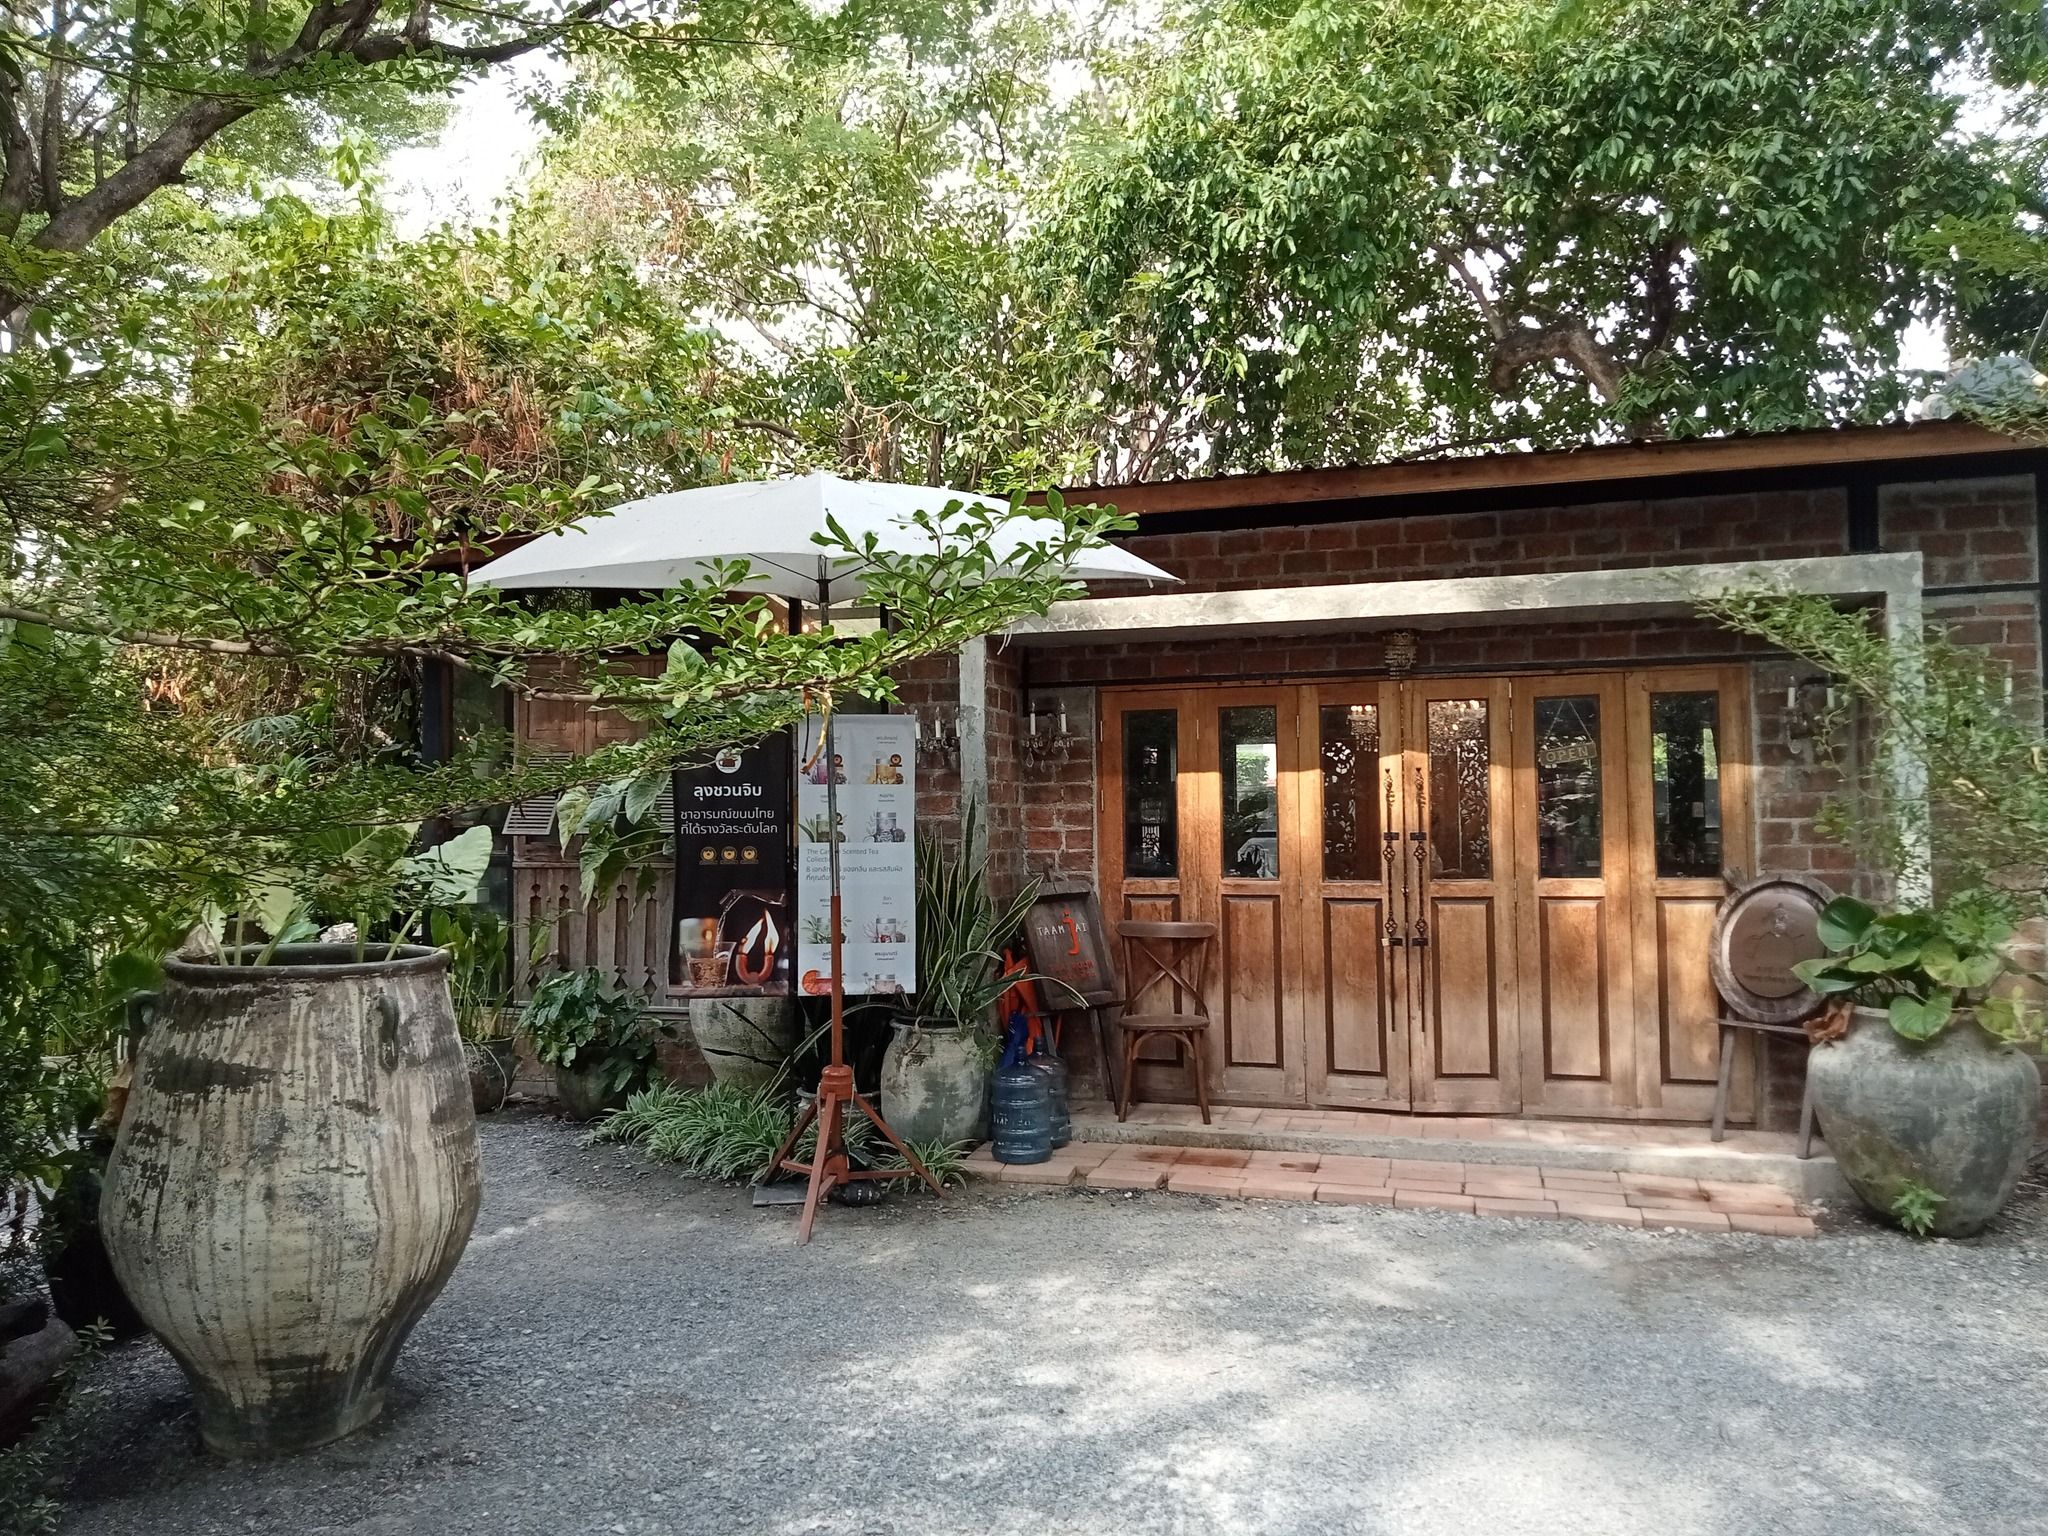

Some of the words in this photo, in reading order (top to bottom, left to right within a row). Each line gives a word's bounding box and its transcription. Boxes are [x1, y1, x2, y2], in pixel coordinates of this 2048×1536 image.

[1546, 745, 1588, 762] OPEN
[693, 783, 762, 801] ลุงชวนจิบ
[680, 807, 775, 819] ชาอารมณ์ขนมไทย
[680, 821, 778, 835] ที่ได้รางวัลระดับโลก
